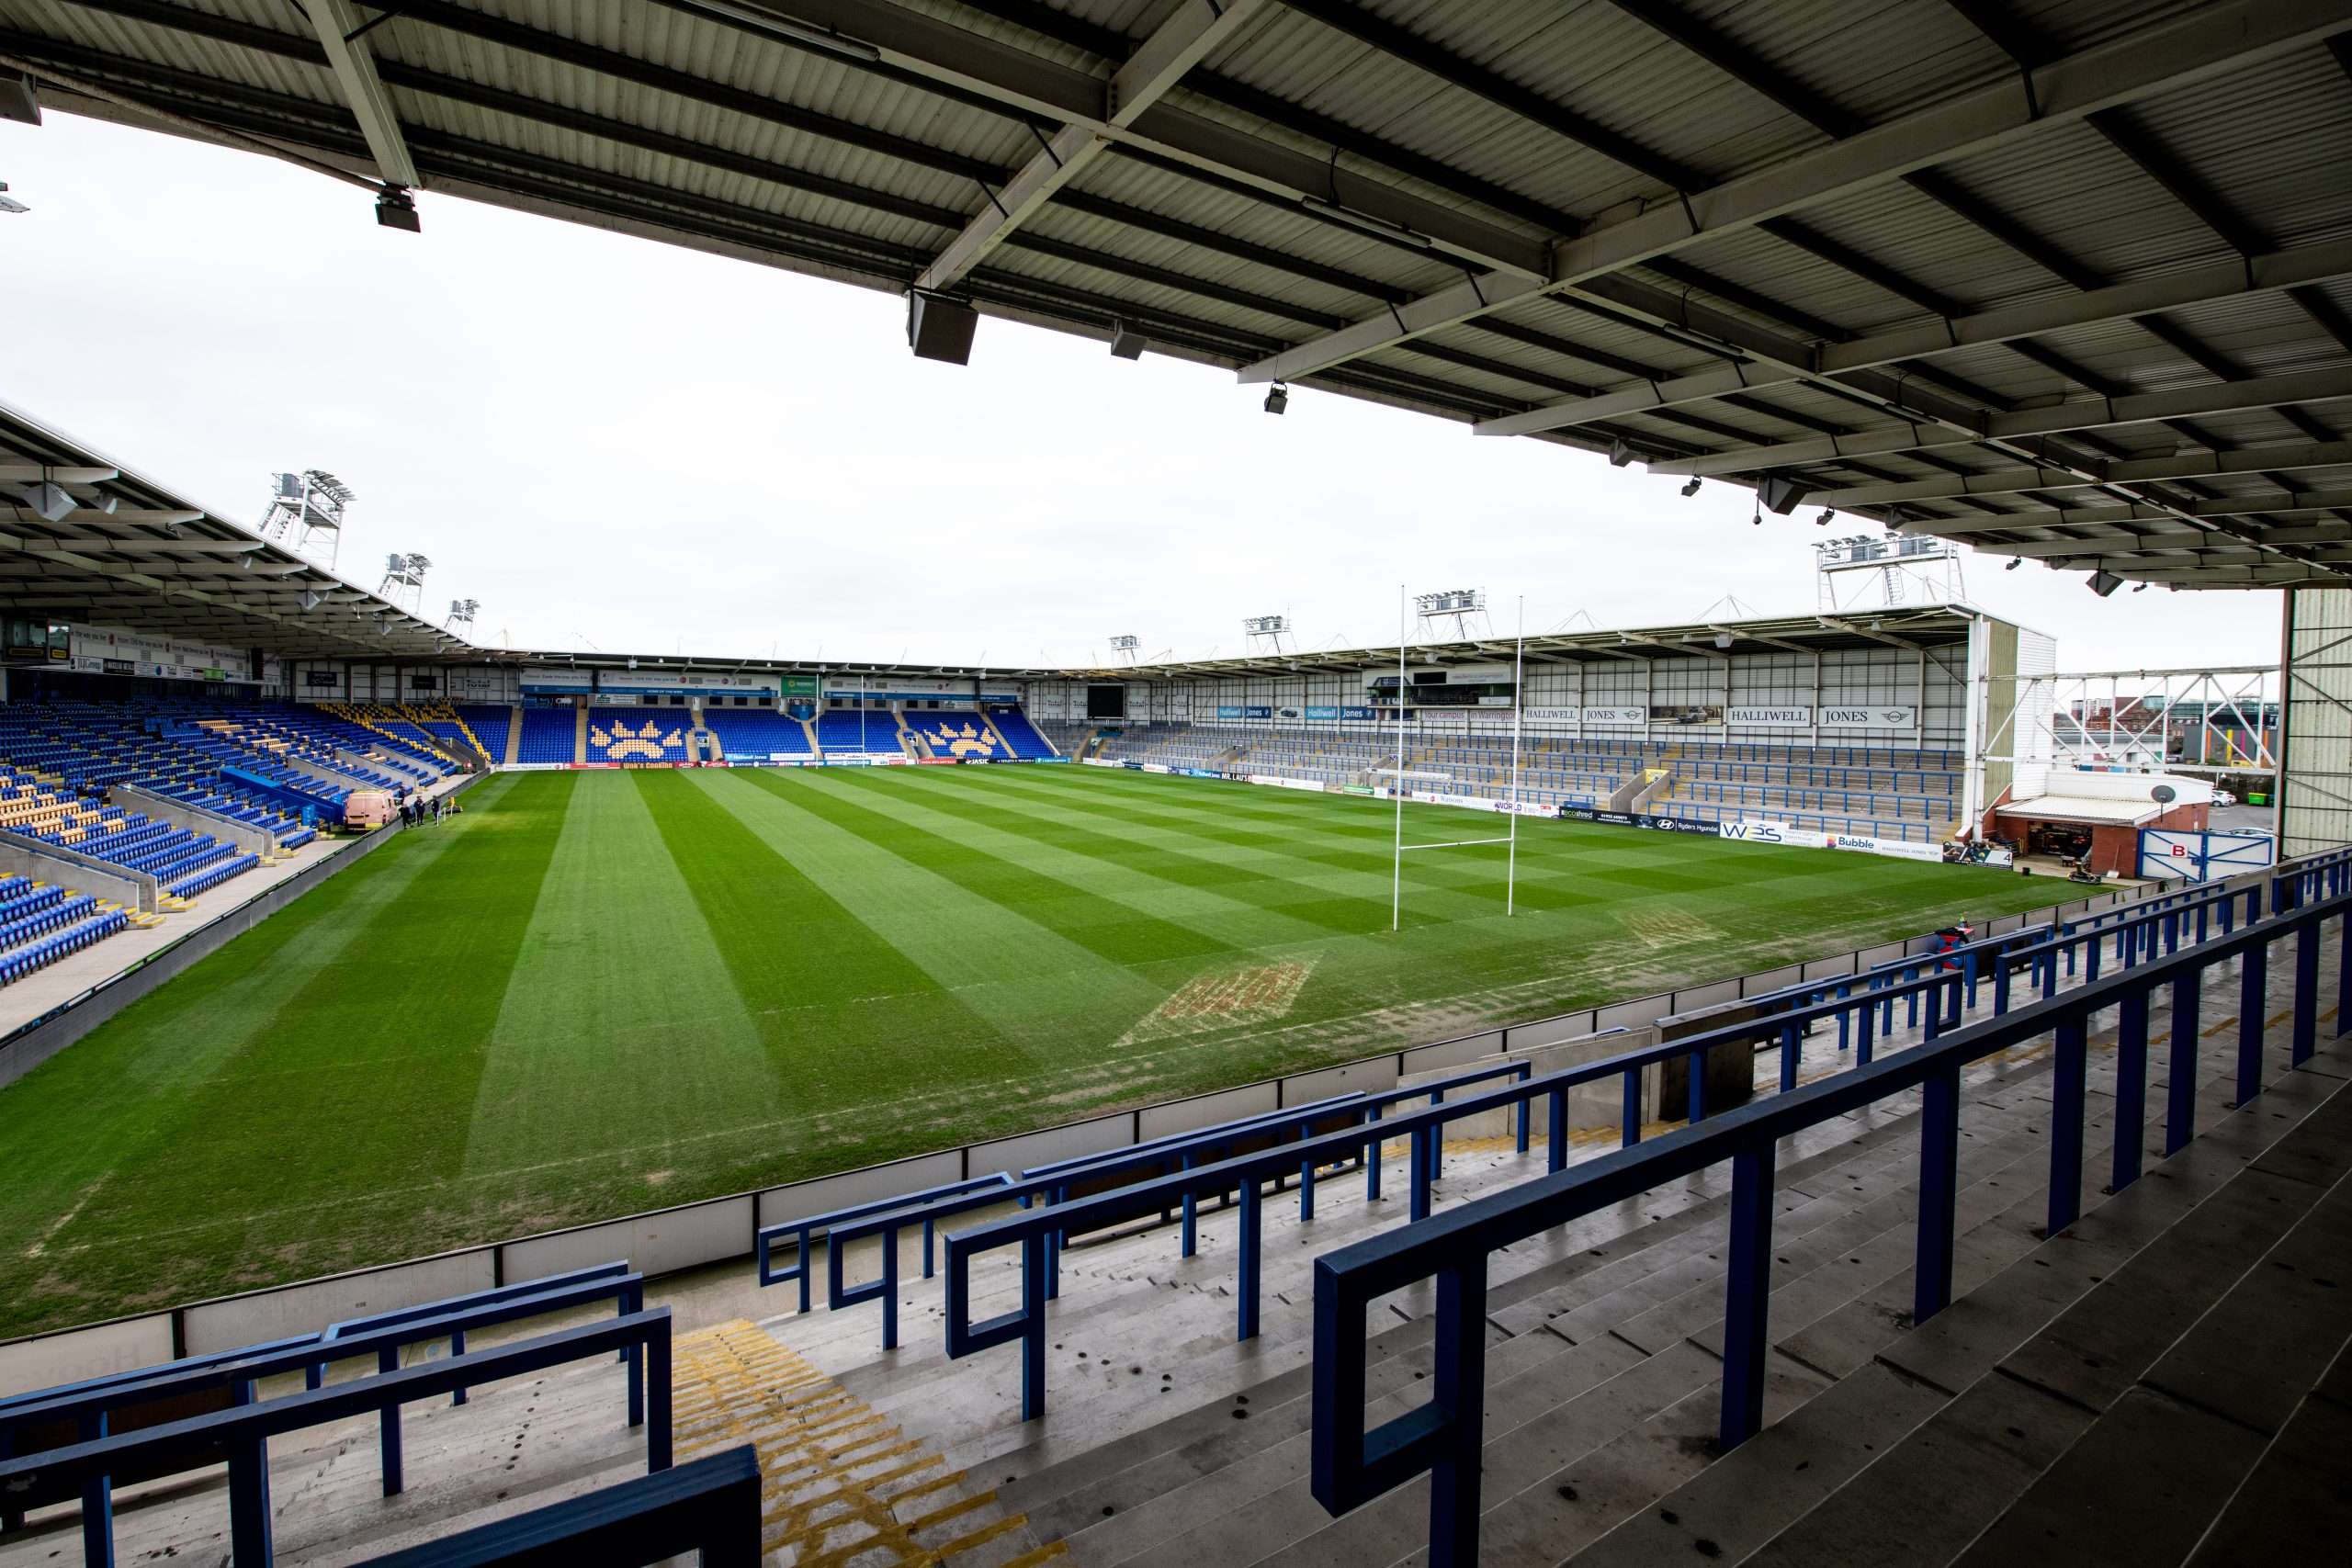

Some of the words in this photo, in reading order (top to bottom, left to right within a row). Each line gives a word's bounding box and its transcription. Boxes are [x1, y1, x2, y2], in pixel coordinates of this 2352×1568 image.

[1308, 708, 1336, 717] Halliwell
[1342, 708, 1363, 718] Jones
[1526, 709, 1576, 719] HALLIWELL
[1587, 710, 1615, 721] JONES
[1732, 710, 1806, 722] HALLIWELL
[1825, 710, 1868, 724] JONES
[1838, 837, 1875, 850] Bubble
[2172, 845, 2185, 856] B
